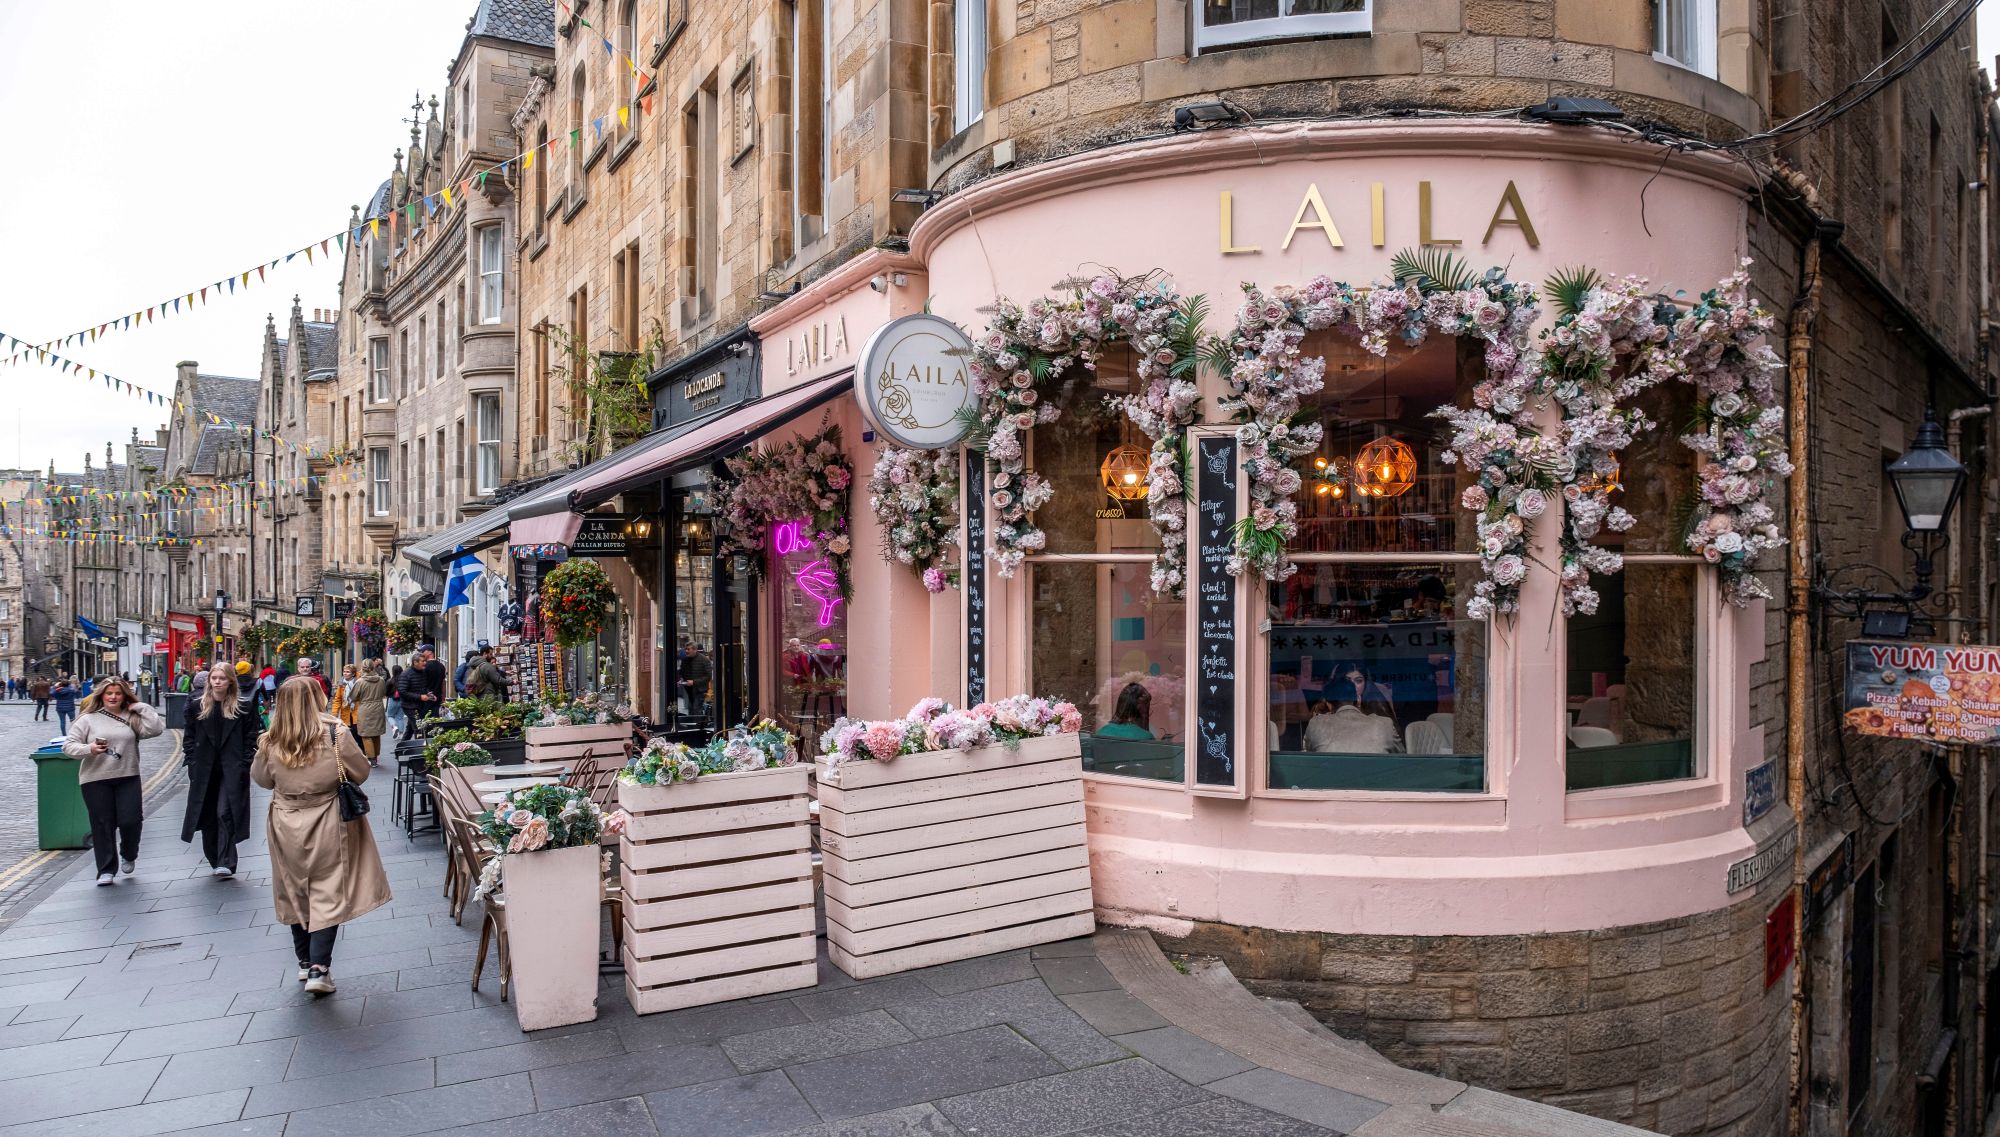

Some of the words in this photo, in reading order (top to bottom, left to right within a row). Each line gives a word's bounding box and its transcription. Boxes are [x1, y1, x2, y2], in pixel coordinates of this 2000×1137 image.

[1219, 180, 1541, 253] LAILA
[786, 313, 848, 376] LAILA
[684, 384, 692, 399] LA
[693, 372, 722, 396] LOCANDA
[890, 361, 967, 387] LAILA
[591, 523, 605, 531] LA
[777, 522, 811, 554] Oh
[1871, 646, 1936, 670] YUM
[1866, 692, 1898, 704] Pizzas
[1911, 695, 1948, 707] Kebabs
[1883, 707, 1922, 720] Burgers
[1935, 711, 1957, 722] Fish
[1960, 712, 1969, 723] &
[1972, 713, 2000, 727] Chips
[1893, 722, 1927, 734] Falafel
[1940, 726, 1957, 737] Hot
[1960, 727, 1986, 740] Dogs
